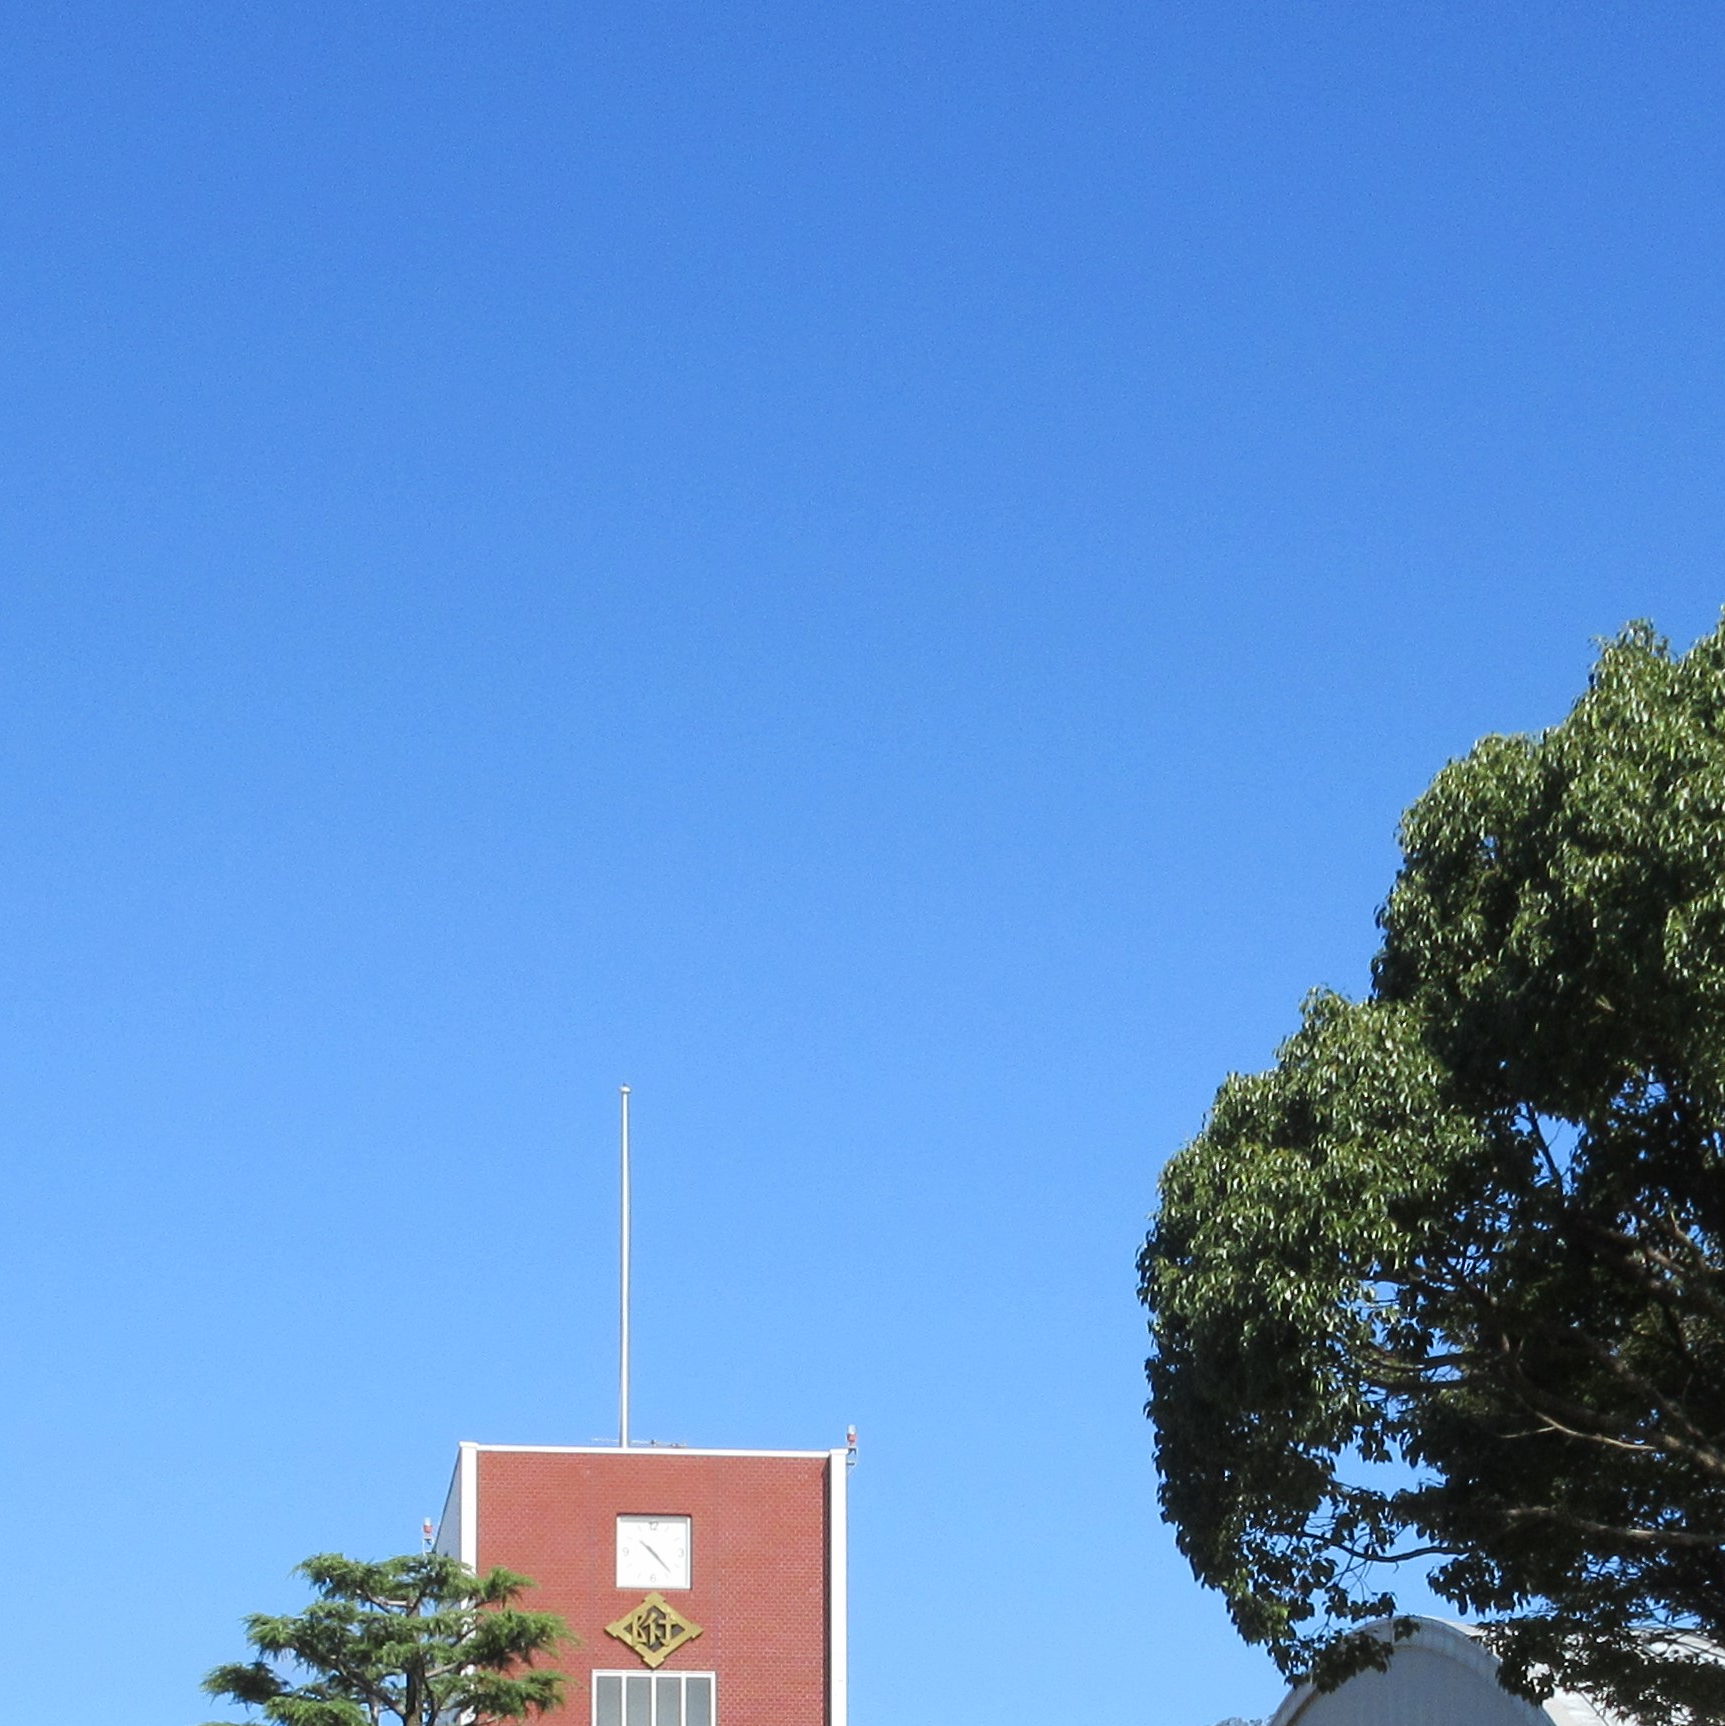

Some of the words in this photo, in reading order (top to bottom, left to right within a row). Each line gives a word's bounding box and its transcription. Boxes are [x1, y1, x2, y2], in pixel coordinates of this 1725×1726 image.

[622, 1547, 630, 1557] 9
[677, 1548, 685, 1558] 3
[649, 1573, 657, 1583] 6
